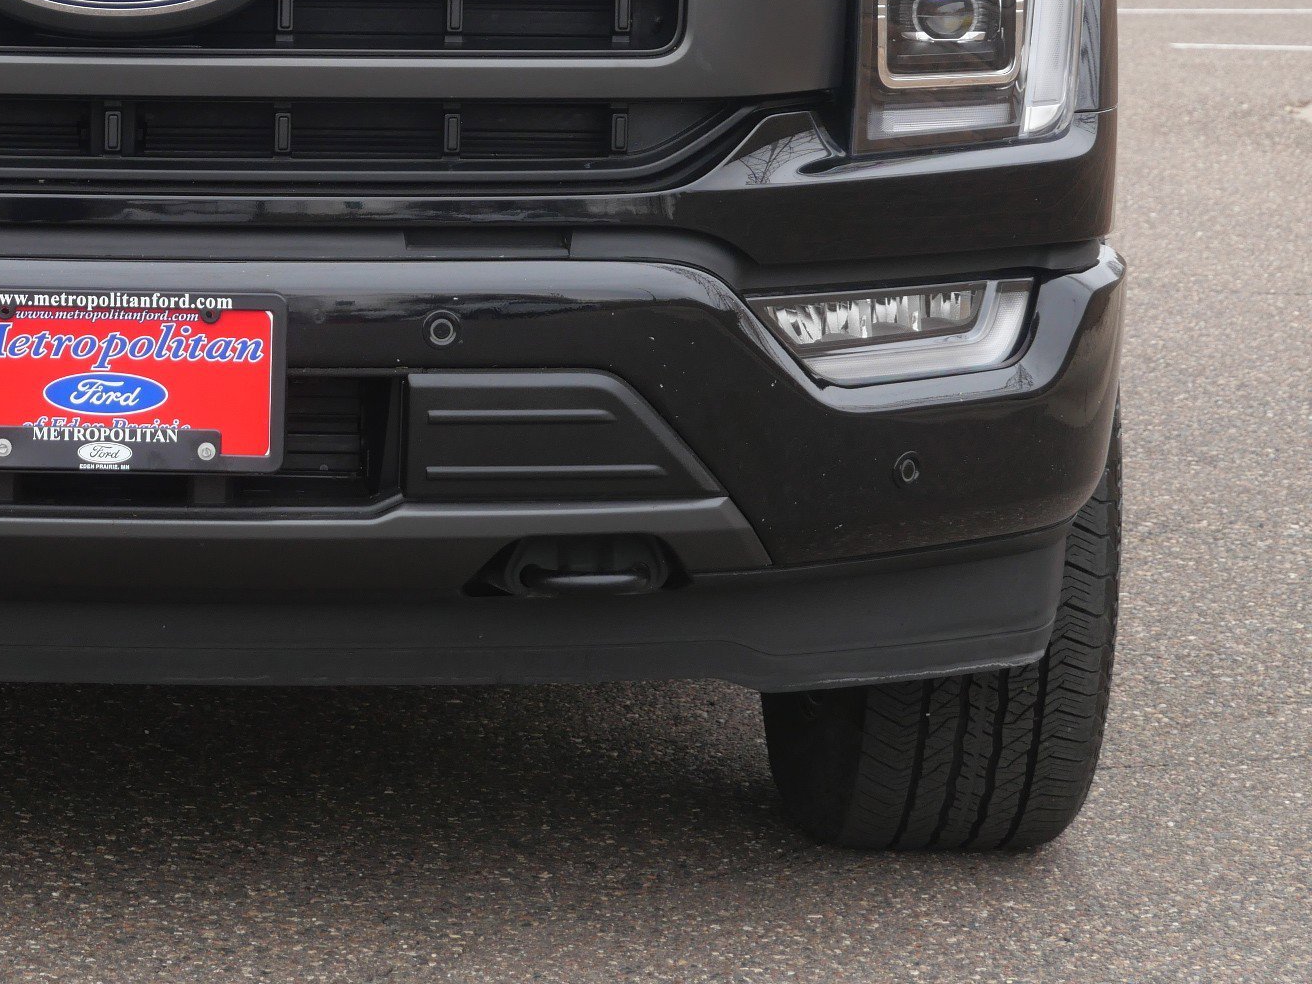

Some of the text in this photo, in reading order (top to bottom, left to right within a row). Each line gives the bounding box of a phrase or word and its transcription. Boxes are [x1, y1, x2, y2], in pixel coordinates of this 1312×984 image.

[15, 308, 199, 323] www.metropolitanford.com
[70, 378, 142, 407] Ford
[32, 426, 179, 443] METROPOLITAN
[90, 444, 120, 459] Ford
